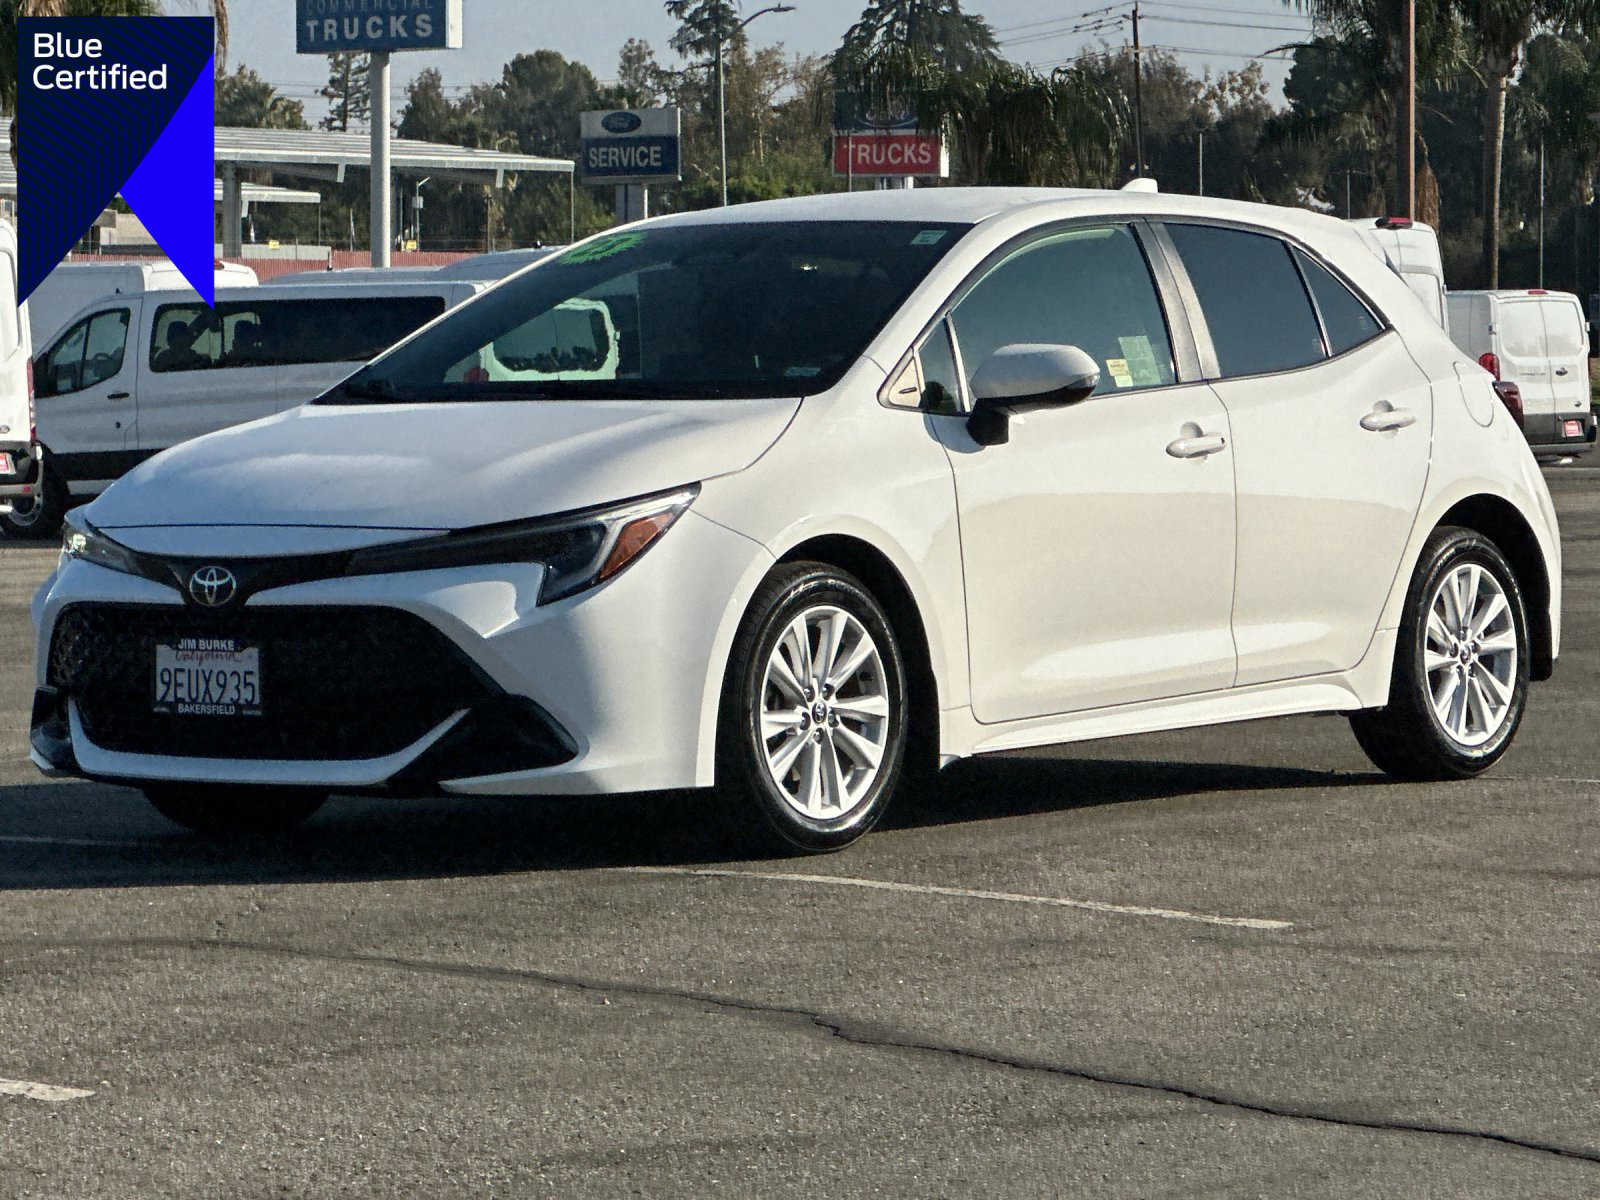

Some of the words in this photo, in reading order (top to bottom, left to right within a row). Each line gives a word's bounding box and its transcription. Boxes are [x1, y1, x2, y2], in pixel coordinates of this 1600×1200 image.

[306, 14, 433, 43] TRUCKS
[588, 145, 662, 168] SERVICE
[178, 638, 197, 650] JIM
[198, 639, 235, 651] BURKE
[160, 667, 256, 705] 9EUX935
[178, 703, 236, 715] BAKERSFIELD
